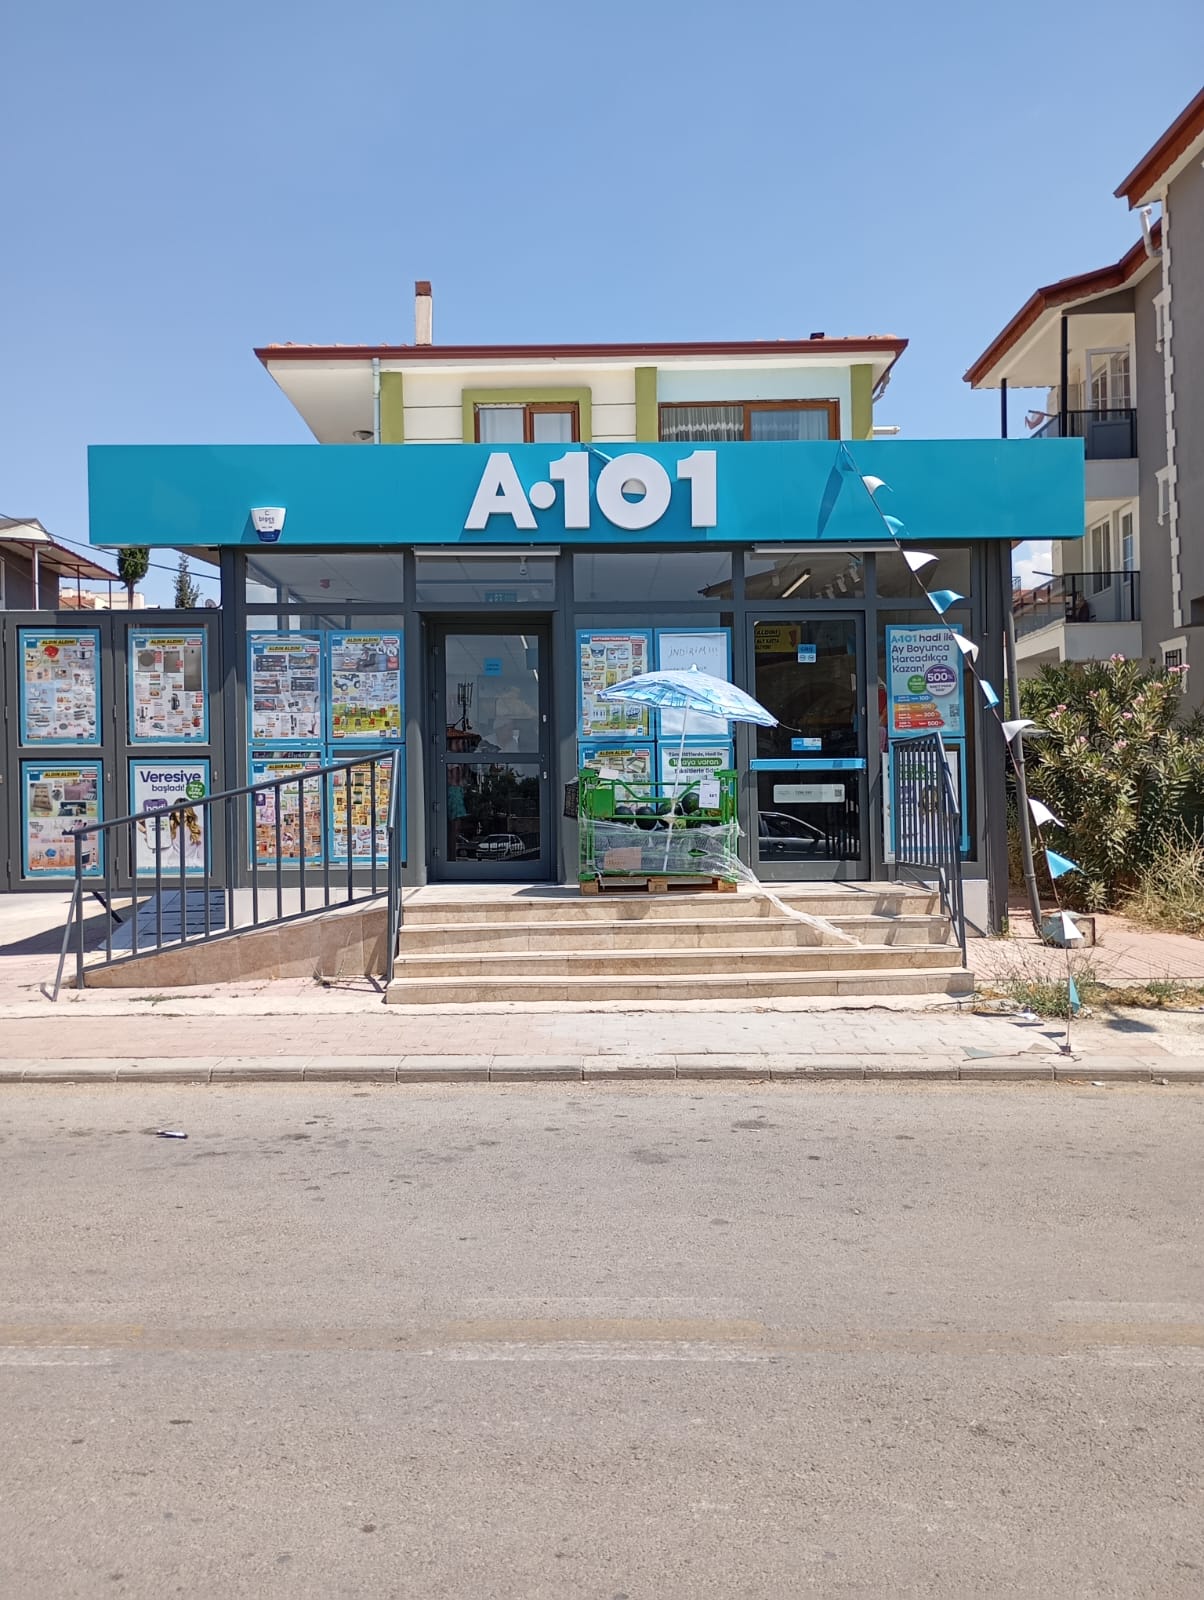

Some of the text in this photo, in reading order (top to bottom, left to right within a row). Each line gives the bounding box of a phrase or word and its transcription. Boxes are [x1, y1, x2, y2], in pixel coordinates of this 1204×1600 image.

[891, 644, 950, 655] Ay Boyunca
[892, 664, 925, 673] Kazan!
[927, 672, 948, 682] 500
[140, 769, 202, 785] Veresiye
[152, 784, 185, 794] başladı!
